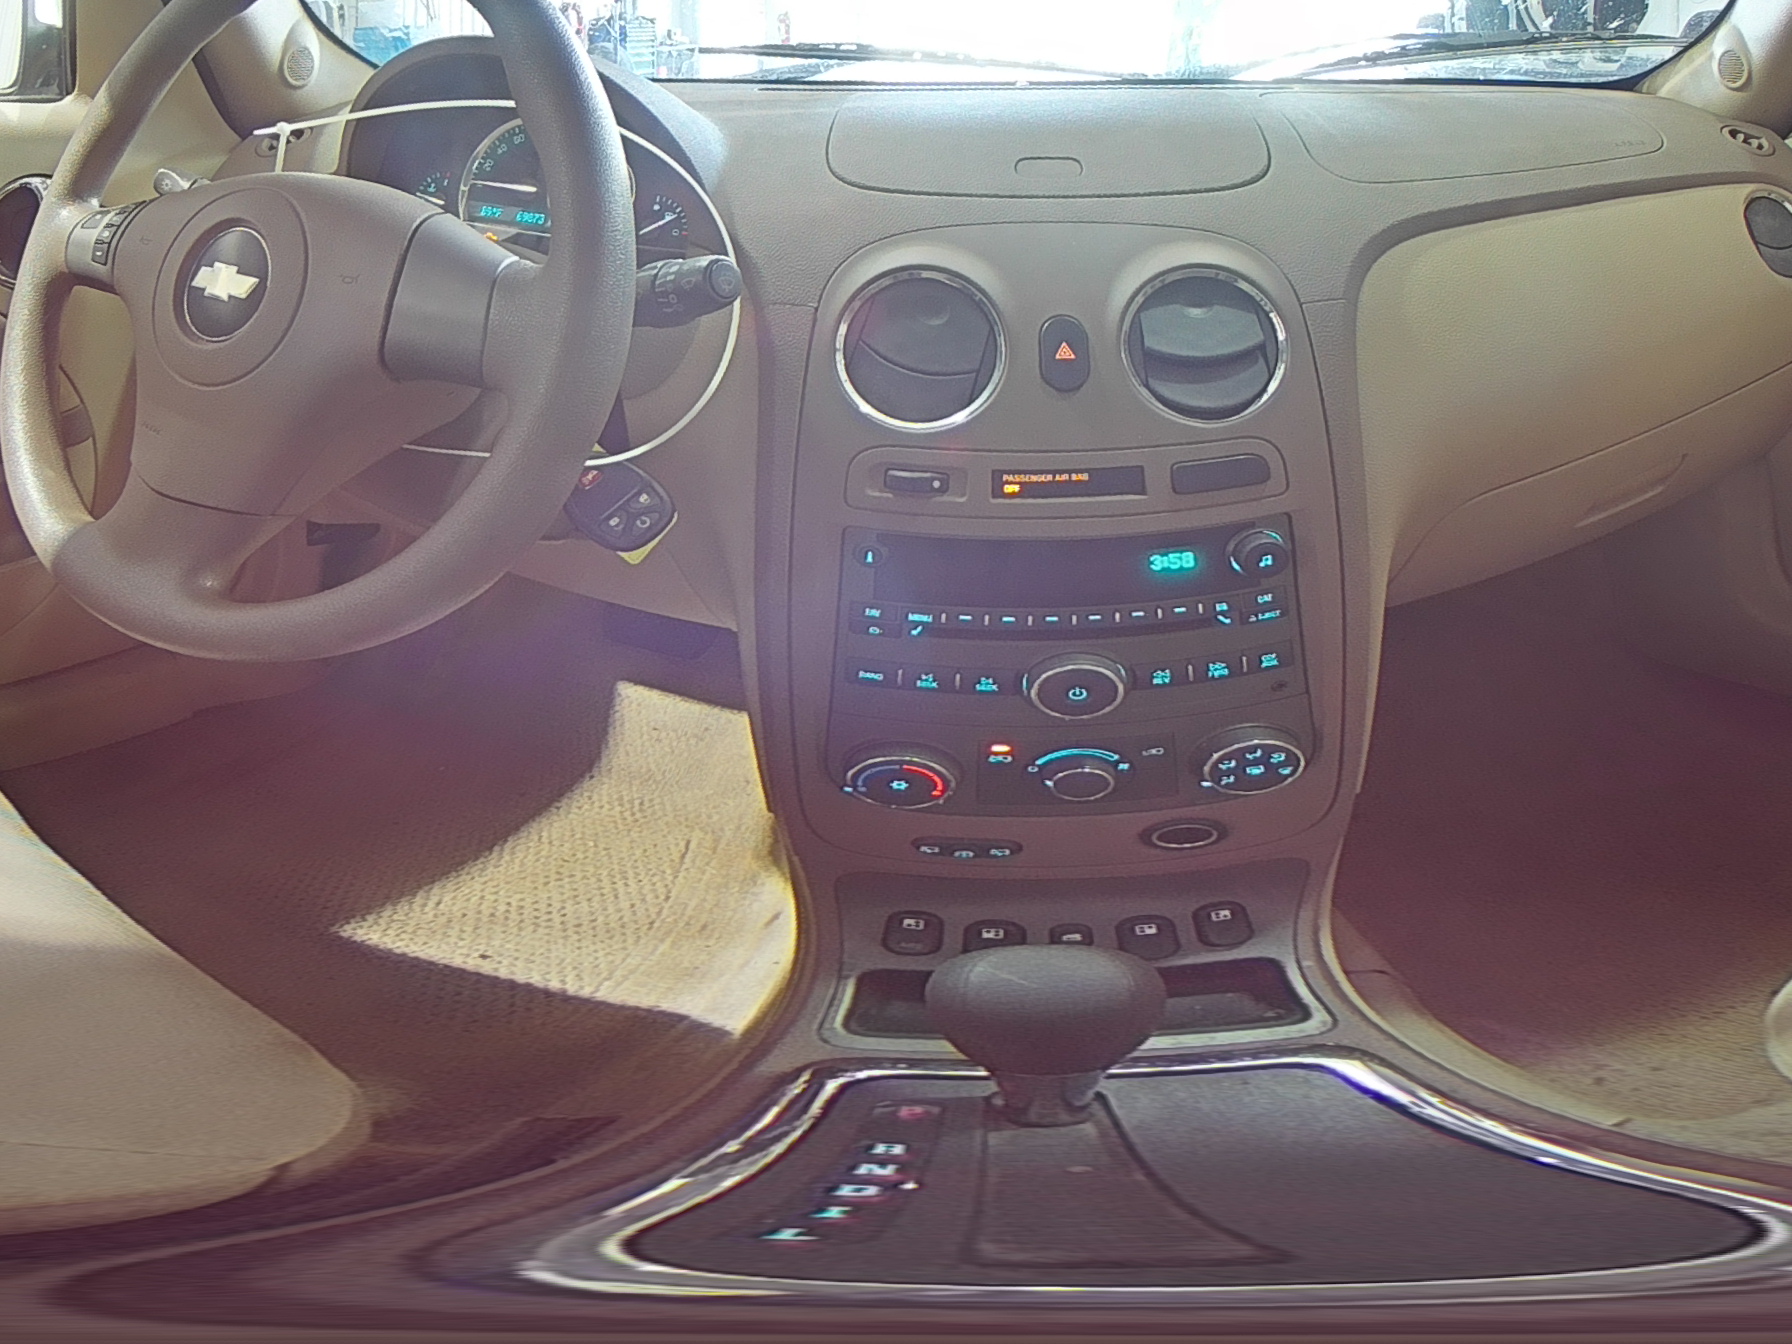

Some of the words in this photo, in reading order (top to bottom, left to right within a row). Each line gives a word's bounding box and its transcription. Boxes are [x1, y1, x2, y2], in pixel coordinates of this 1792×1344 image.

[1002, 473, 1053, 482] PASSENGER
[1054, 473, 1069, 481] AIR
[1003, 485, 1020, 493] OFF
[1149, 551, 1196, 571] 3:58
[853, 1163, 899, 1175] N
